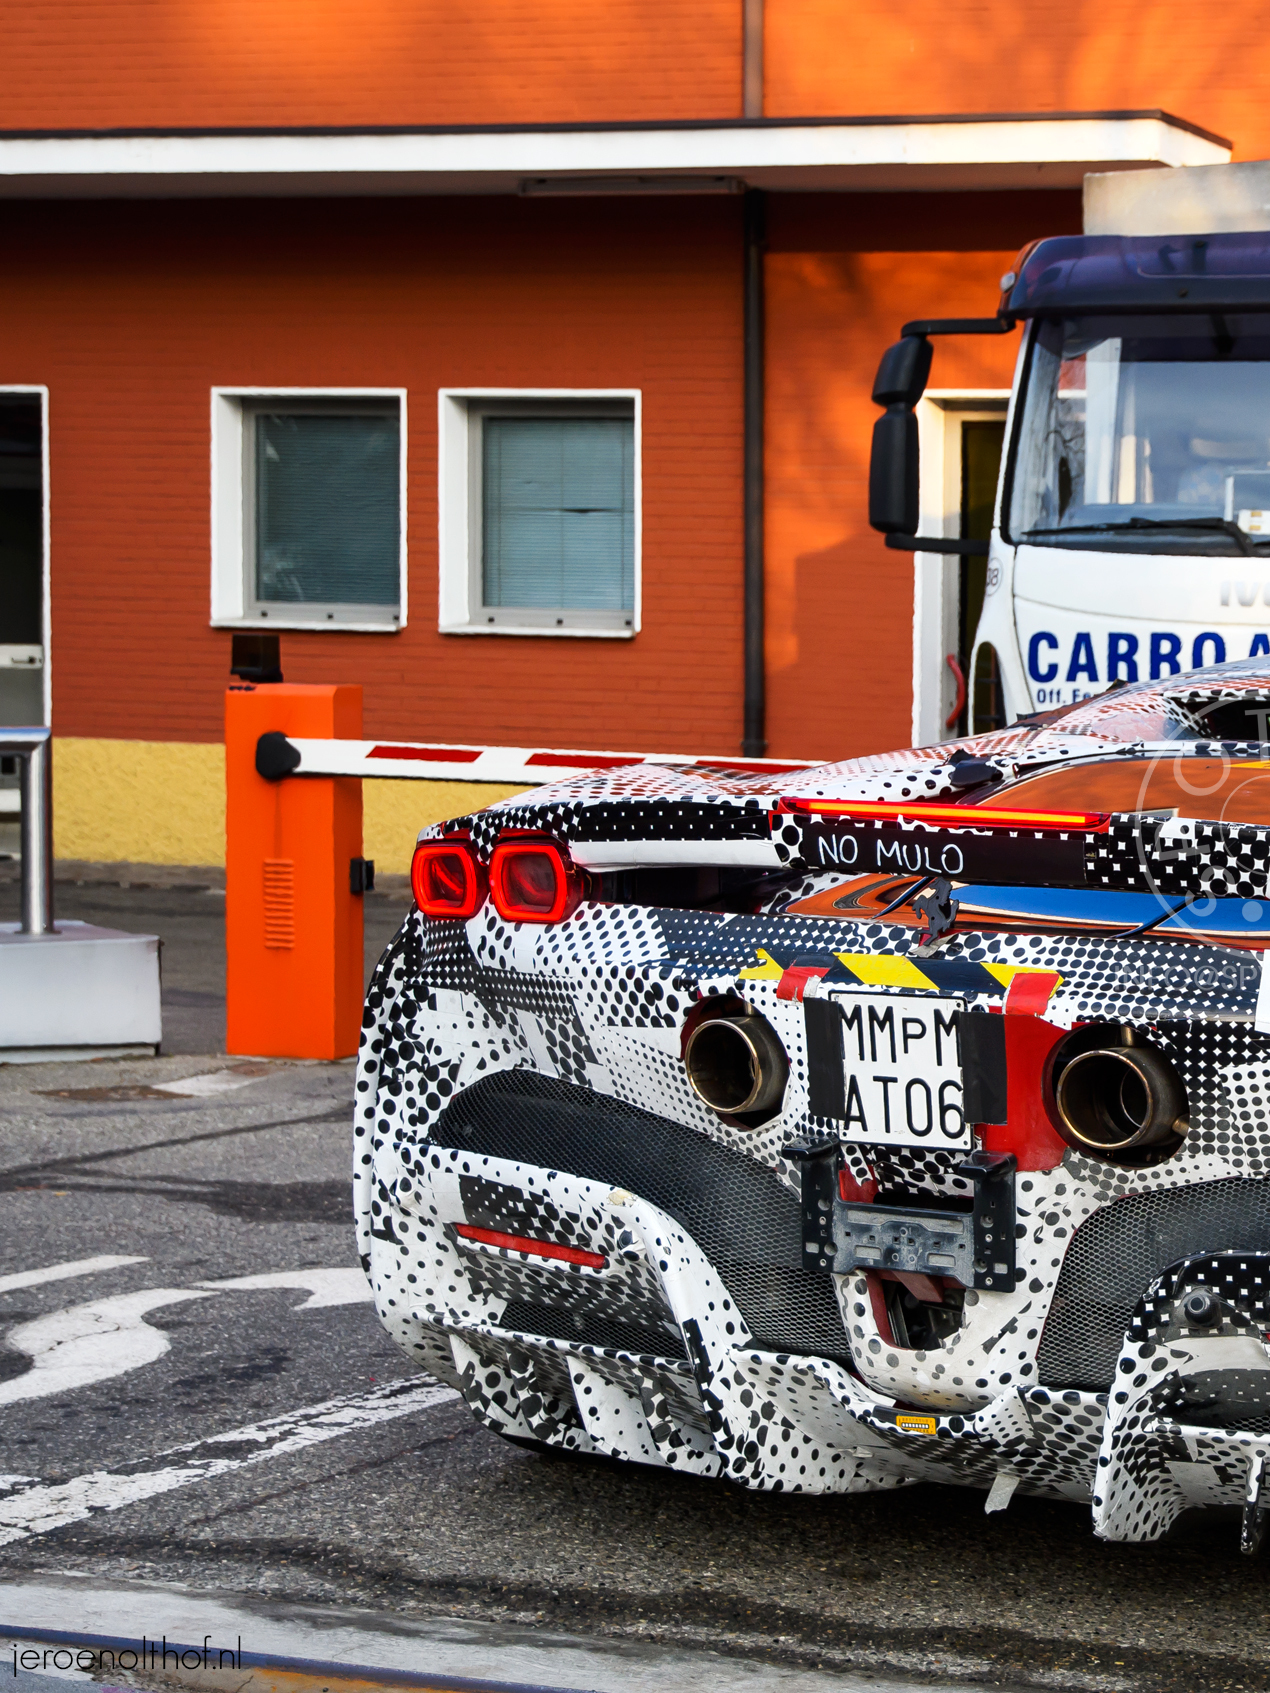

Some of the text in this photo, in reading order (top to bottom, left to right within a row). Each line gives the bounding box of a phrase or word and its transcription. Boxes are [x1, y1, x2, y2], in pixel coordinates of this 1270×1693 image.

[1028, 631, 1226, 684] CARRO
[818, 833, 965, 875] NO MULO
